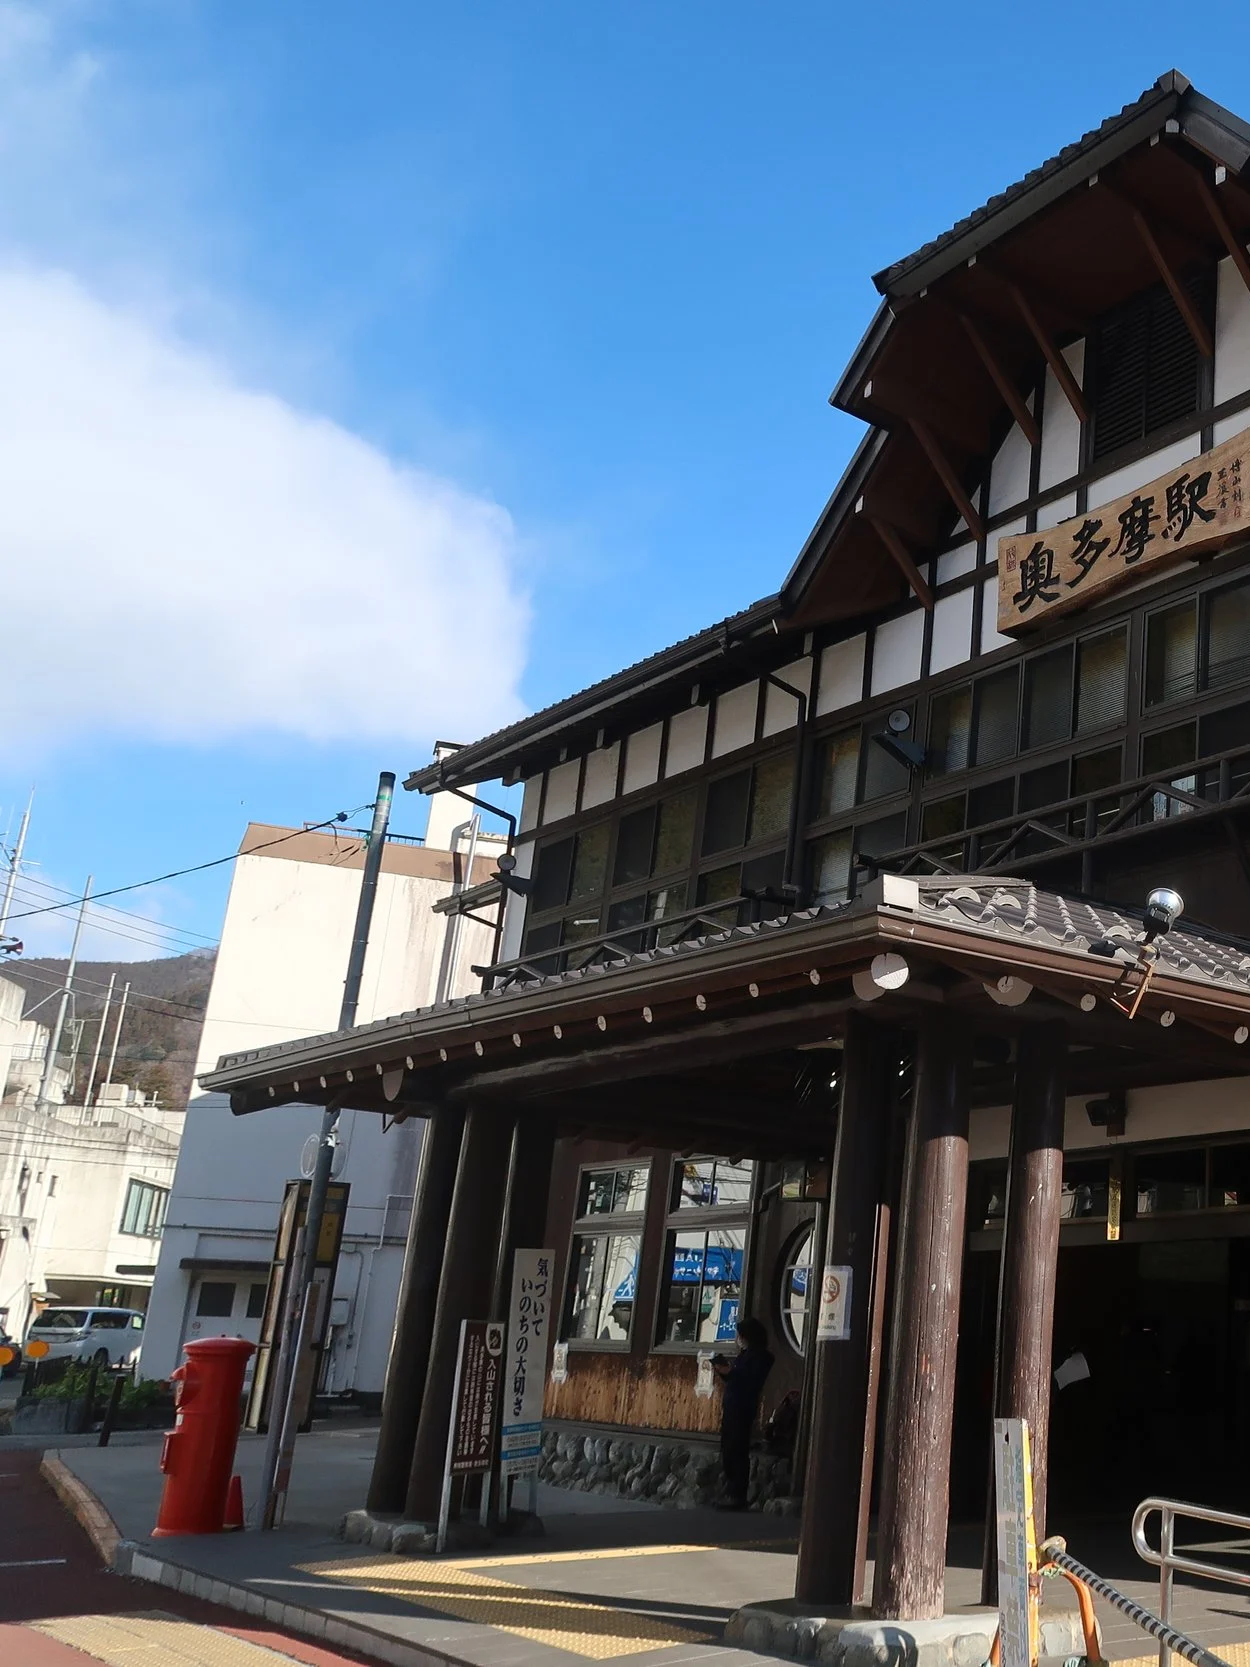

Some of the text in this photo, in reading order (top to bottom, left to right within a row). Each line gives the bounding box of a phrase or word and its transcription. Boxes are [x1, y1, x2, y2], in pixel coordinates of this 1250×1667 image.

[1013, 471, 1216, 613] 奥多摩駅
[513, 1277, 533, 1417] いのちの大切さ
[531, 1257, 549, 1338] 気づいて
